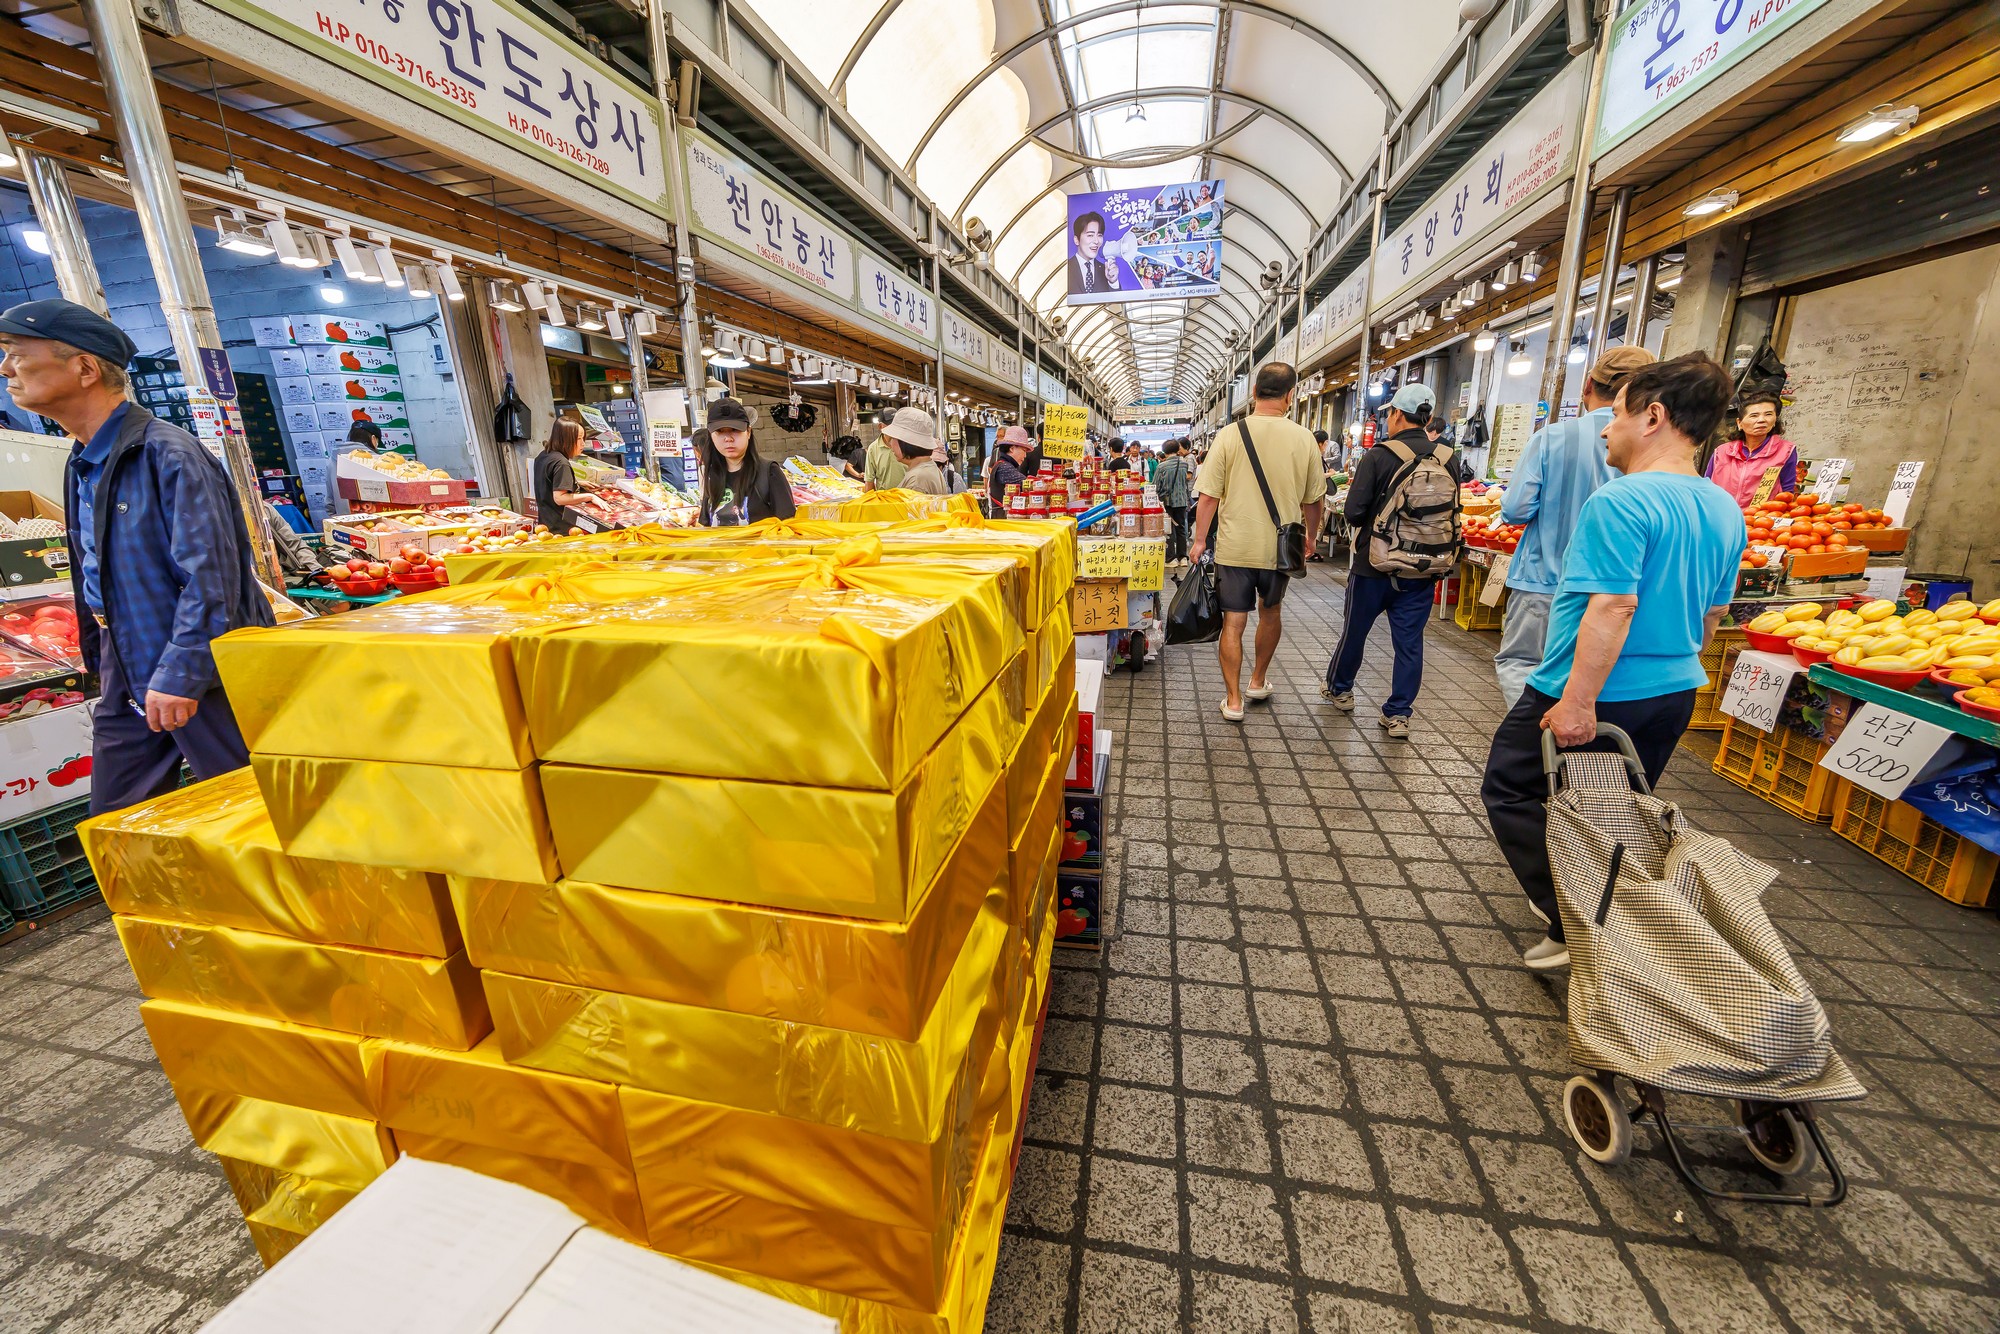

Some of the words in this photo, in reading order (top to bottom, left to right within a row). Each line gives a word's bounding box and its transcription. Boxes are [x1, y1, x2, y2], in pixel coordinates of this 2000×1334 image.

[1629, 0, 1670, 38] 청과위
[316, 11, 350, 43] H.P
[355, 32, 477, 109] 010-3716-5335
[1665, 41, 1720, 95] 963-7573
[428, 0, 646, 176] 한도상사
[508, 111, 530, 135] H.P
[532, 128, 610, 176] 010-3126-7289
[692, 147, 706, 167] 청과
[726, 175, 835, 280] 천안농산
[1401, 151, 1505, 275] 중앙상회
[875, 271, 928, 330] 한농상회
[951, 321, 983, 360] 우성상회
[367, 358, 382, 366] 사과
[372, 386, 388, 394] 사과
[378, 413, 393, 421] 사과
[1046, 406, 1063, 421] 낙지
[1089, 543, 1126, 554] 오징어젓
[1732, 661, 1785, 698] 성주꿀참외
[1864, 714, 1917, 748] 단감
[1836, 747, 1910, 782] 5000
[0, 776, 40, 800] 과
